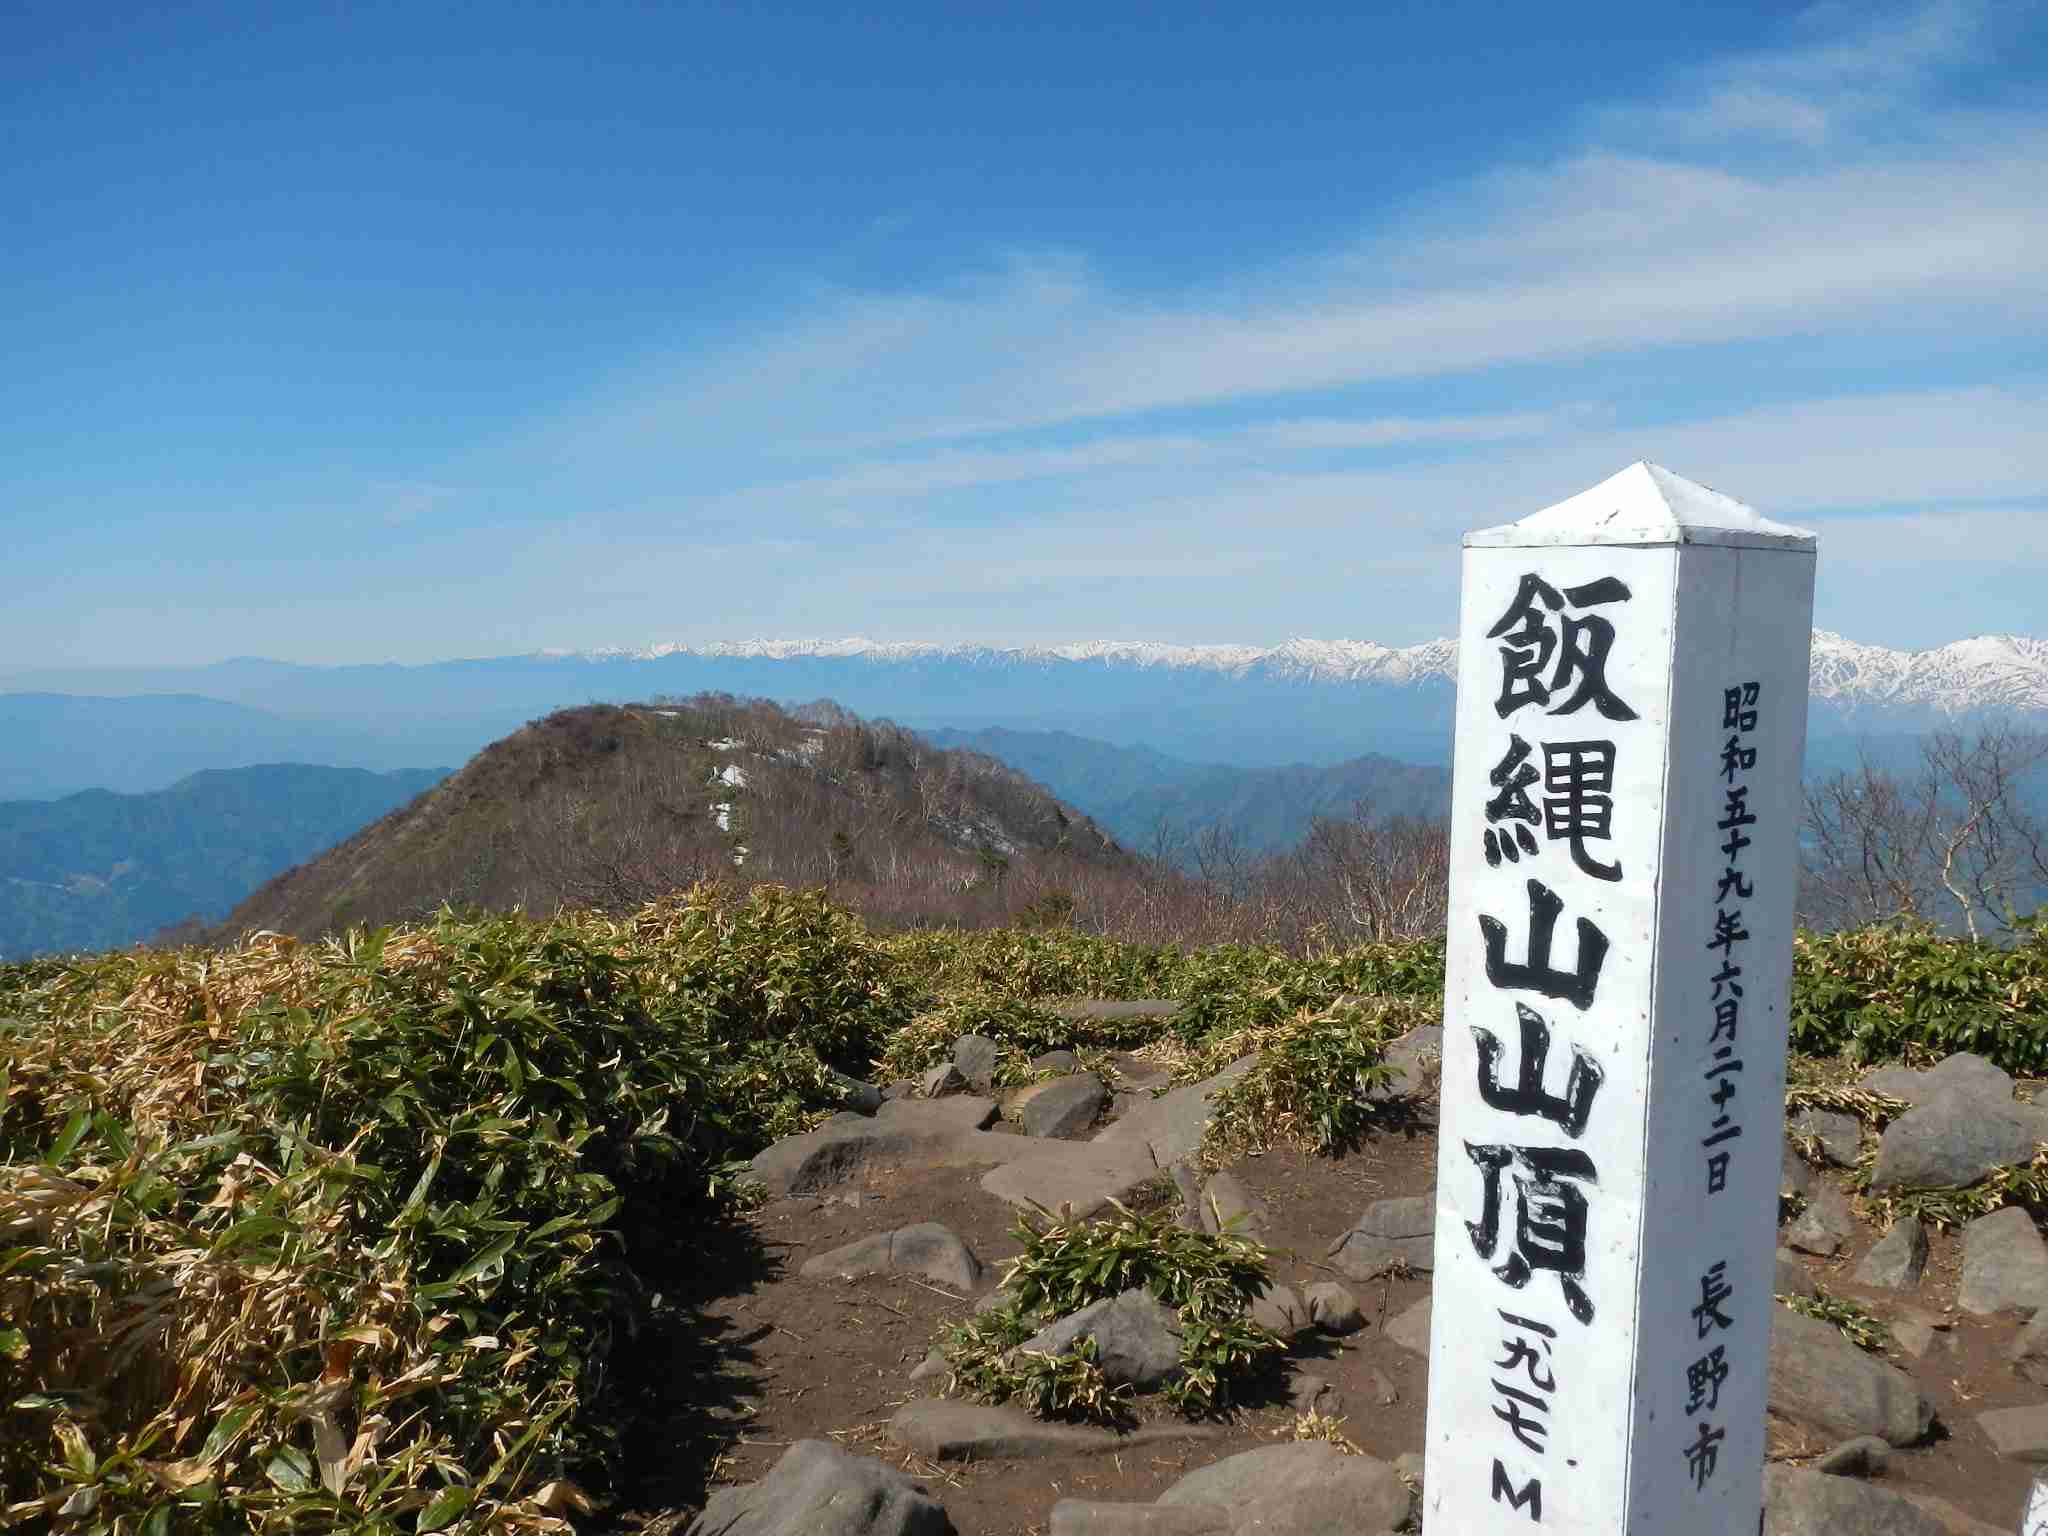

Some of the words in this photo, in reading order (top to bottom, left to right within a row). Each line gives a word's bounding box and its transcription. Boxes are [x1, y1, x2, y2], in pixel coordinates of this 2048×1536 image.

[1464, 572, 1641, 1327] 飯縄山山頂
[1701, 681, 1761, 1195] 昭和五十九年六月二十二日
[1682, 1260, 1734, 1493] 長野市
